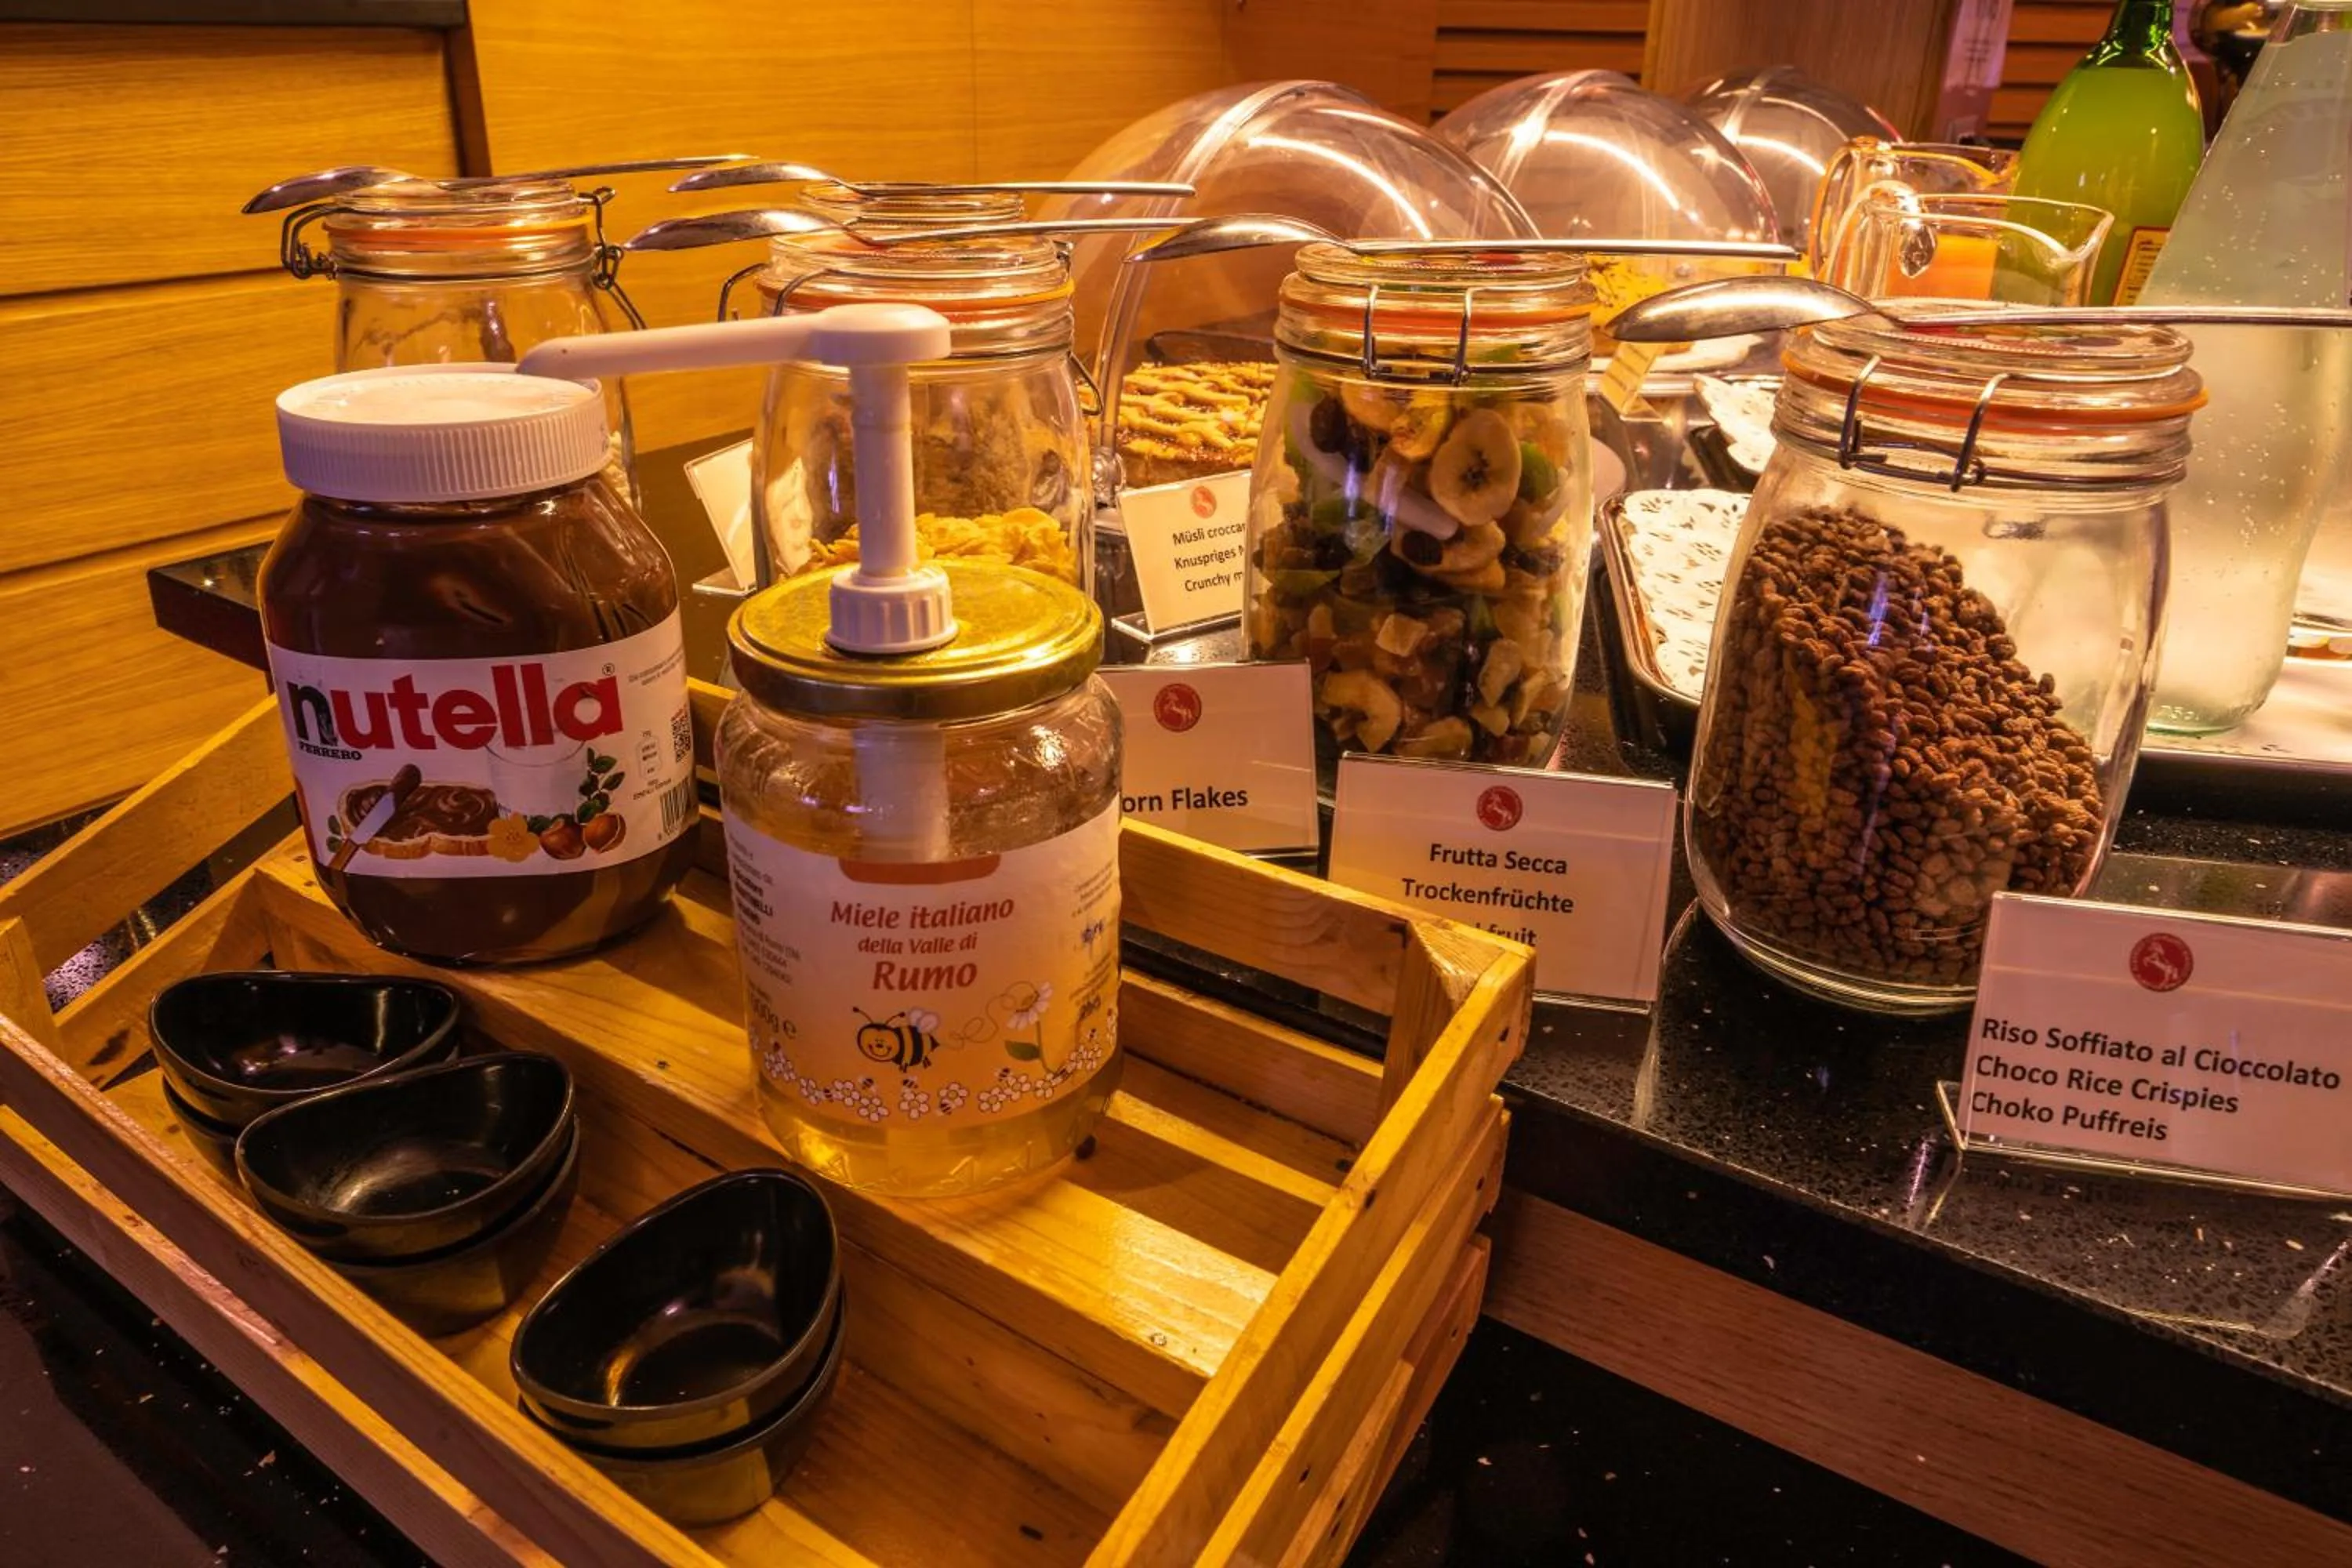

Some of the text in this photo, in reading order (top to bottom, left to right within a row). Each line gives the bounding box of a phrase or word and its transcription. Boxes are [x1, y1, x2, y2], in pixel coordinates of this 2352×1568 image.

[1172, 527, 1205, 546] Müsli
[1174, 548, 1236, 570] Knuspriges
[1185, 572, 1230, 592] Crunchy
[287, 663, 623, 750] nutella
[1122, 786, 1248, 813] orn Flakes
[1429, 843, 1567, 874] Frutta Secca
[1402, 878, 1574, 913] Trockenfrüchte
[830, 898, 1014, 929] Miele italiano
[858, 931, 978, 954] della Valle di
[872, 960, 978, 991] Rumo
[1982, 1018, 2340, 1090] Riso Soffiato al Cioccolato
[1976, 1054, 2239, 1113] Choco Rice Crispies
[1971, 1091, 2168, 1141] Choko Puffreis
